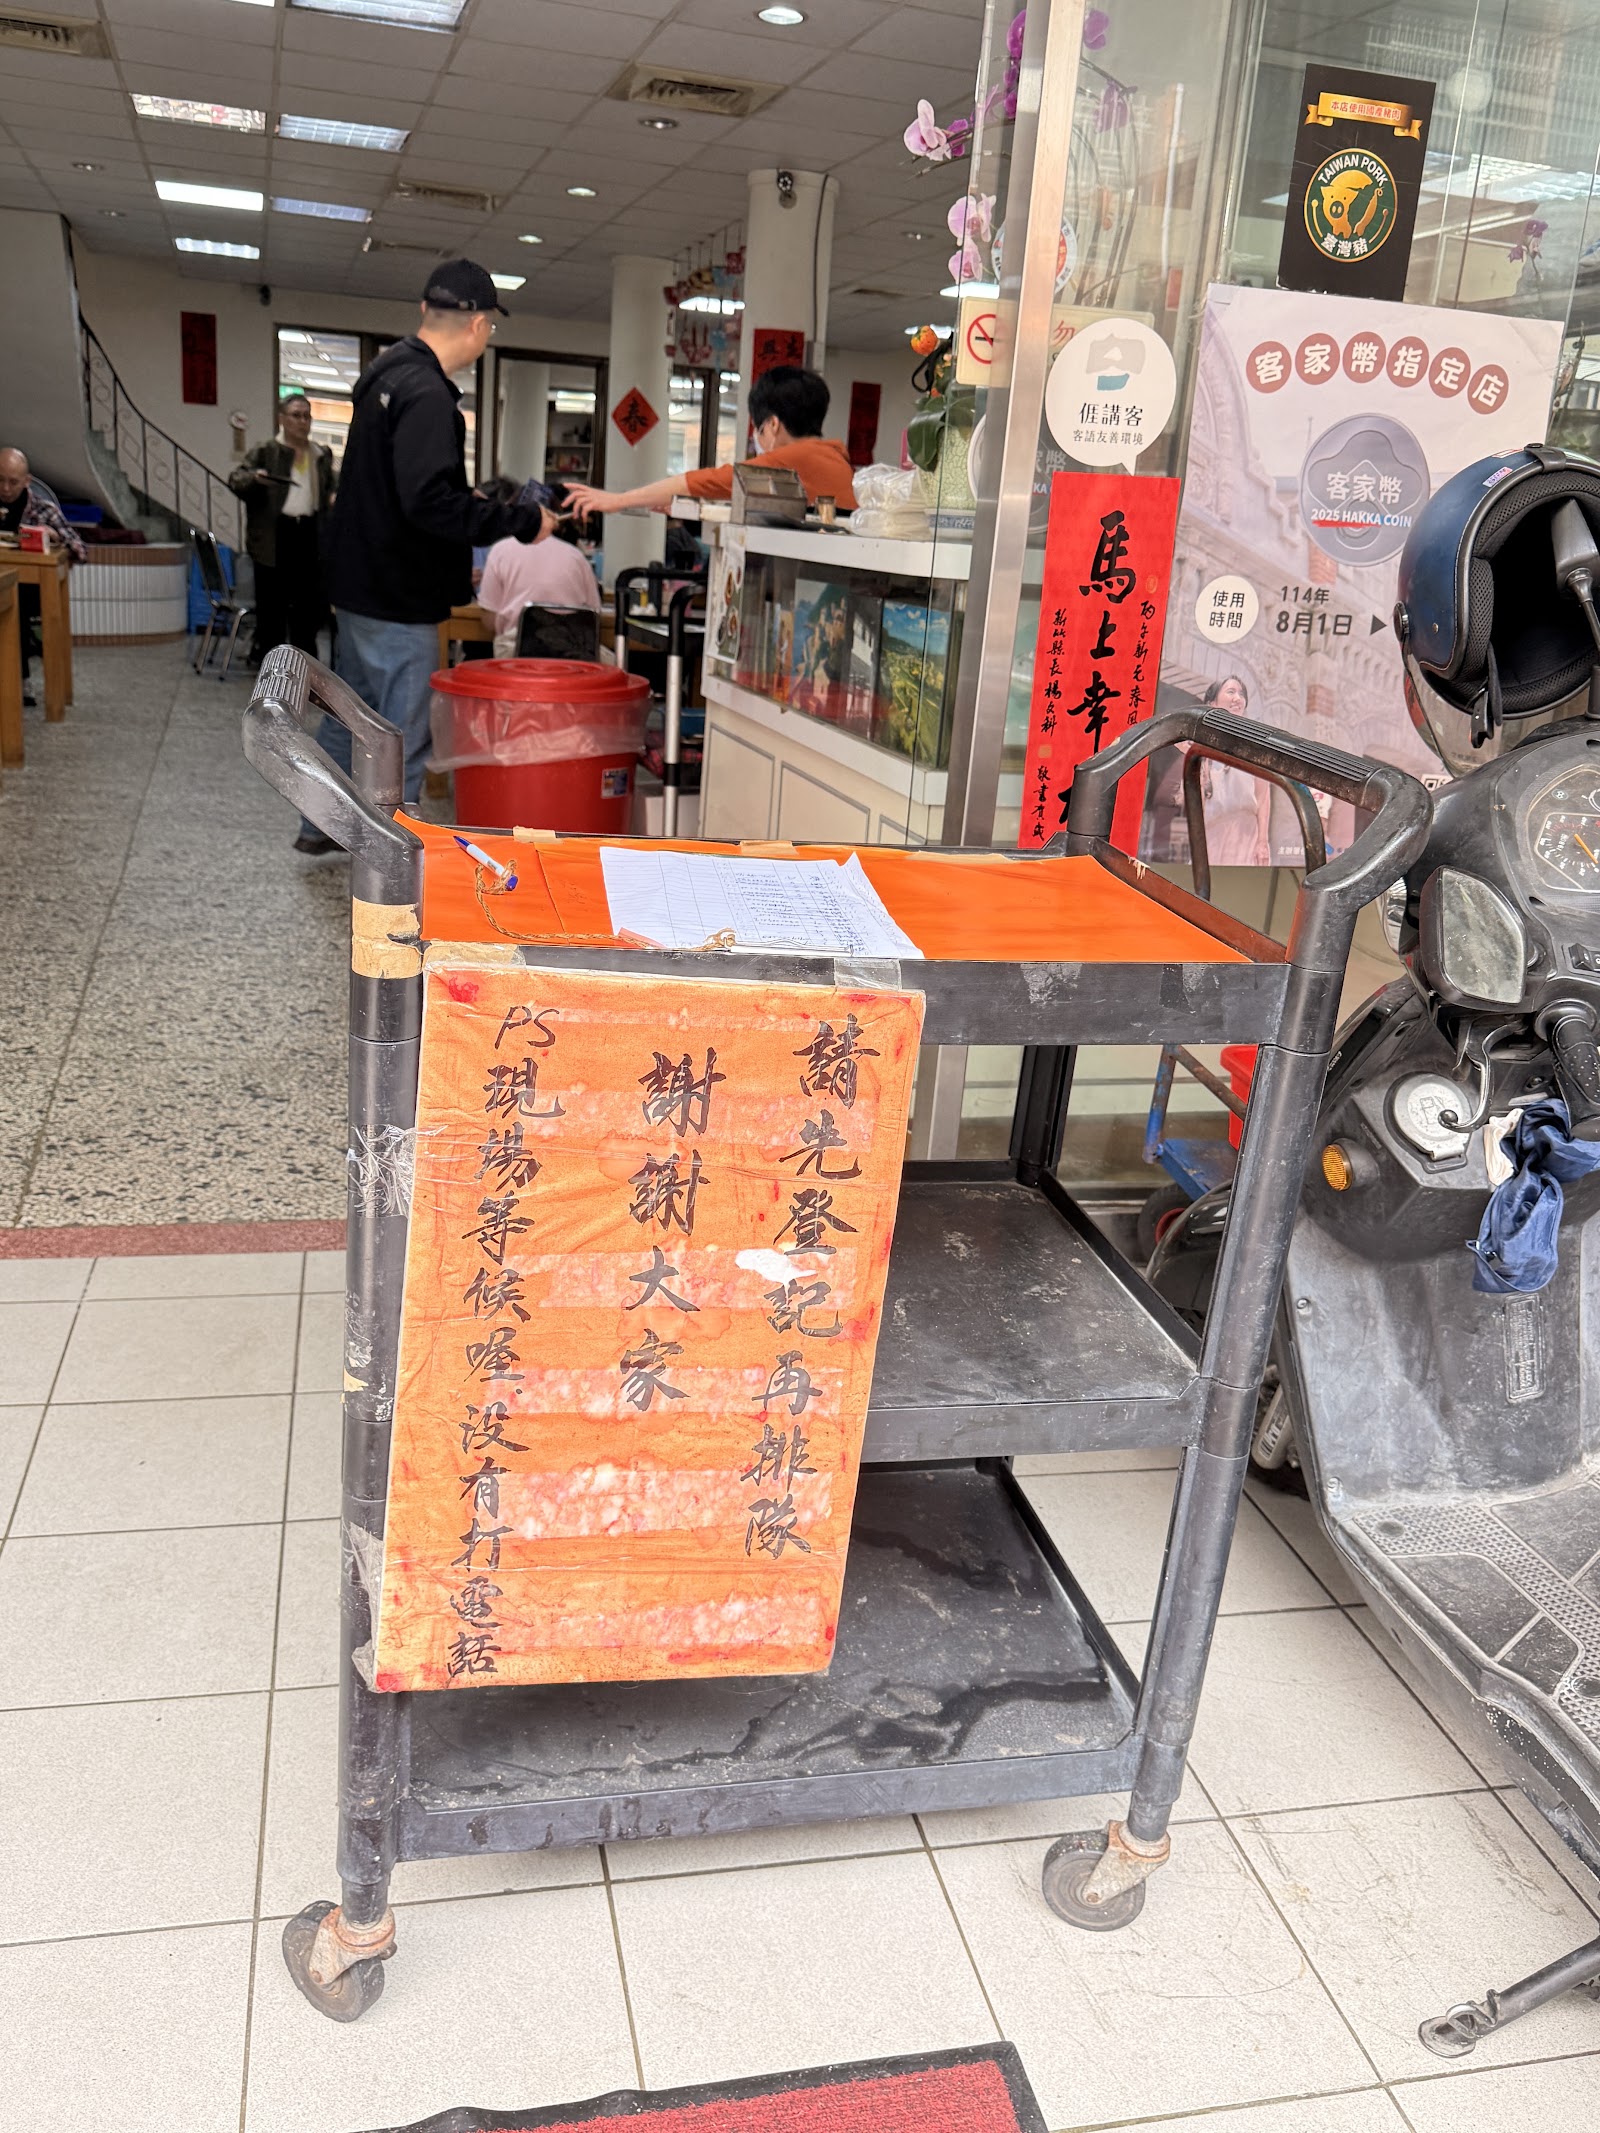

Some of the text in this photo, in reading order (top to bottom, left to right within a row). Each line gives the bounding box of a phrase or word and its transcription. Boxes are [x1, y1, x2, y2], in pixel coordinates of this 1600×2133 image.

[1317, 154, 1388, 186] TAIWAN PORK
[1321, 233, 1368, 257] 臺灣豬
[1254, 341, 1504, 407] 客家幣指定店
[619, 397, 649, 433] 春
[1073, 429, 1143, 445] 客語友善環境
[1326, 472, 1402, 504] 客家幣
[1311, 508, 1412, 527] 2025 HAKKA COIN
[1213, 590, 1245, 608] 使用
[1281, 586, 1330, 605] 114年
[1209, 611, 1243, 629] 時間
[1276, 610, 1353, 635] 8月1日
[1058, 510, 1136, 824] 馬上幸
[494, 1006, 560, 1050] PS
[620, 1047, 726, 1411] 謝謝大家
[740, 1013, 881, 1560] 請先登記再排隊
